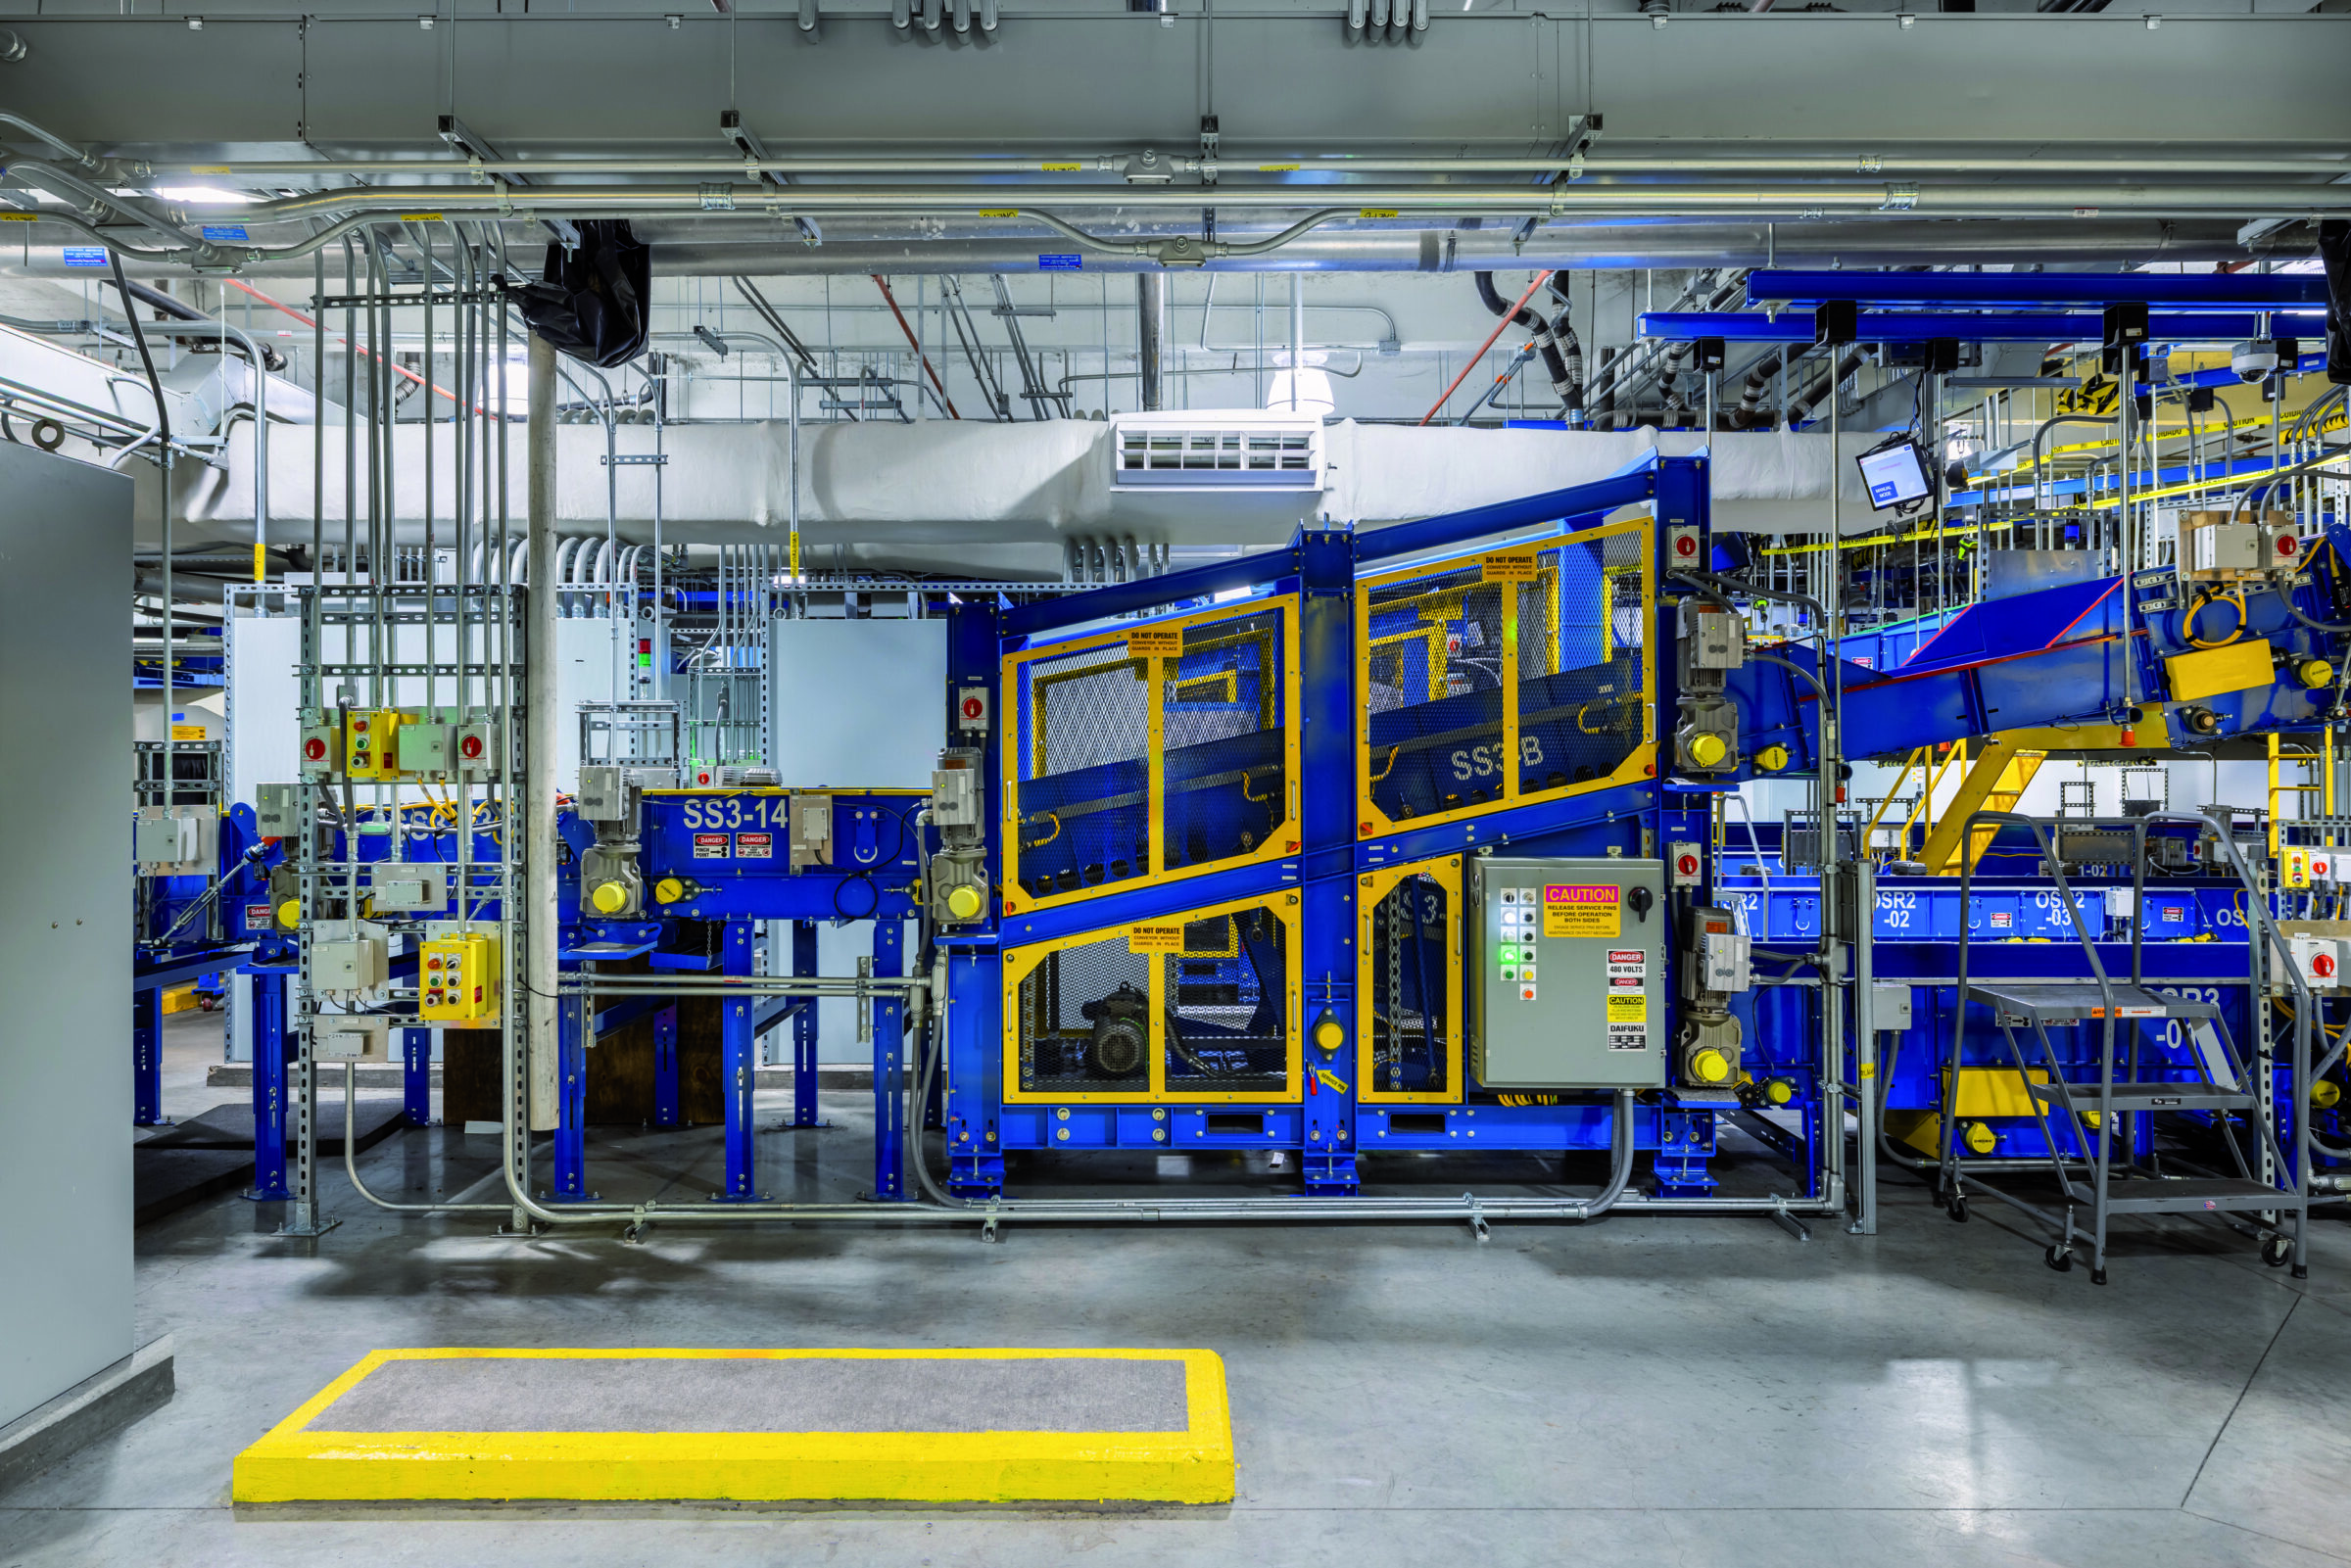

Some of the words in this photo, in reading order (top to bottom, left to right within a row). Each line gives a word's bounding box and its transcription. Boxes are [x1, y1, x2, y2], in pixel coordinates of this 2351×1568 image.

[1451, 736, 1544, 781] SS3B
[683, 798, 789, 830] SS3-14
[1550, 888, 1615, 901] CAUTION
[1884, 910, 1910, 927] -02
[2045, 908, 2072, 926] -03
[1321, 1072, 1338, 1085] SERVICE
